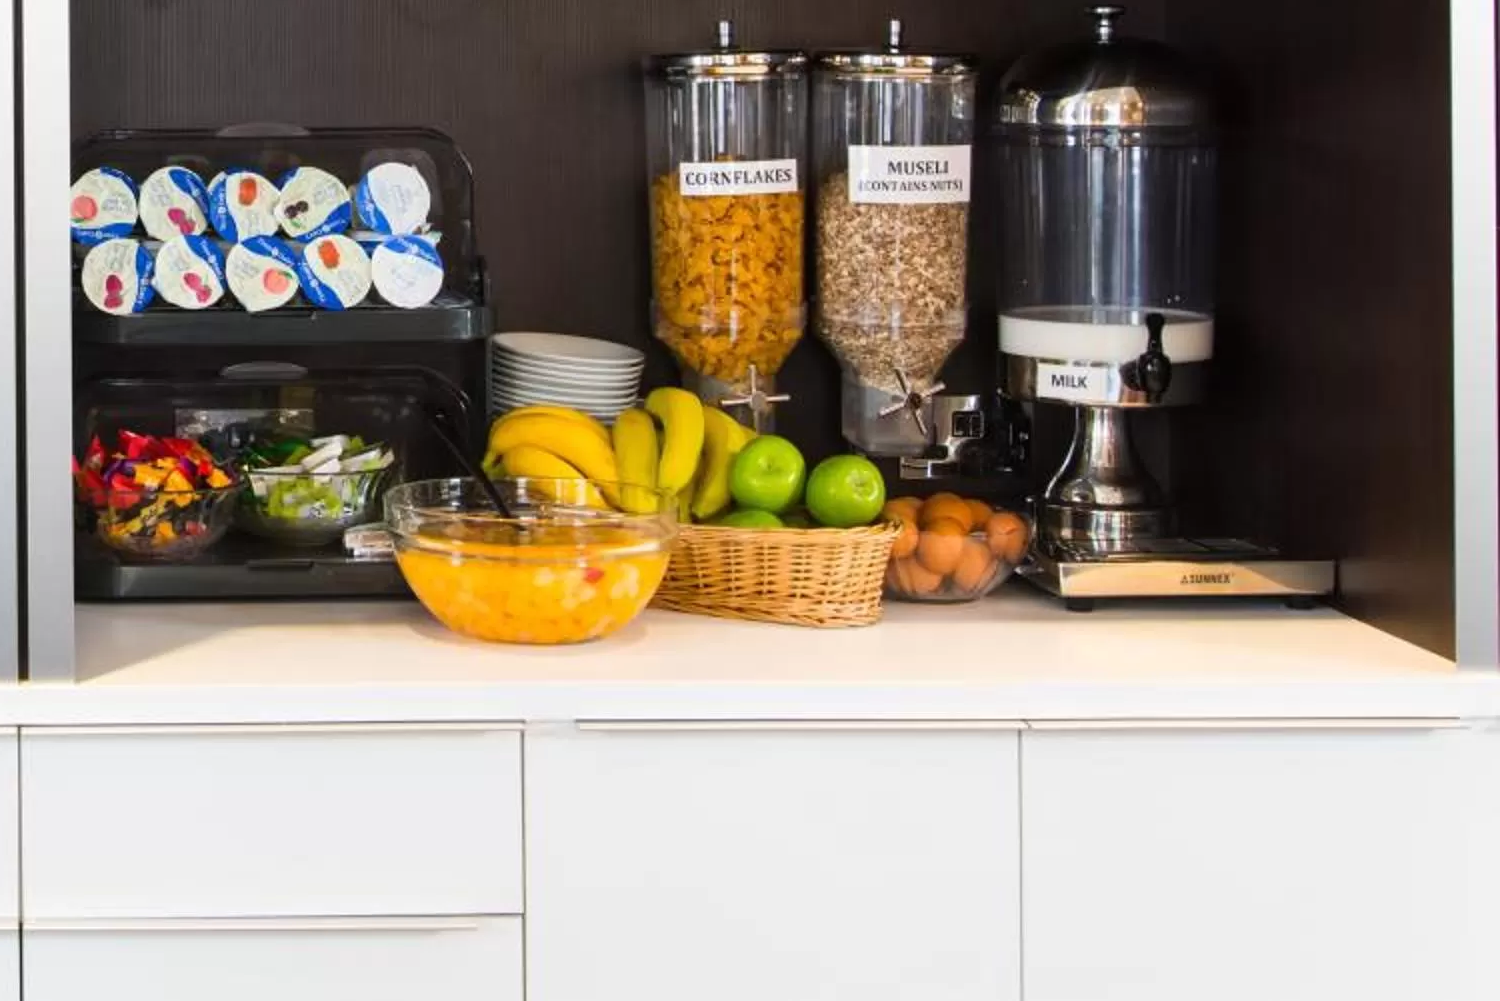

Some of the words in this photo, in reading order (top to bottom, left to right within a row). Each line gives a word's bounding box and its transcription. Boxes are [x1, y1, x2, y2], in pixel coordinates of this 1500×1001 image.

[886, 159, 950, 175] MUSELI
[684, 167, 793, 187] CORNFLAKES
[1051, 374, 1088, 389] MILK
